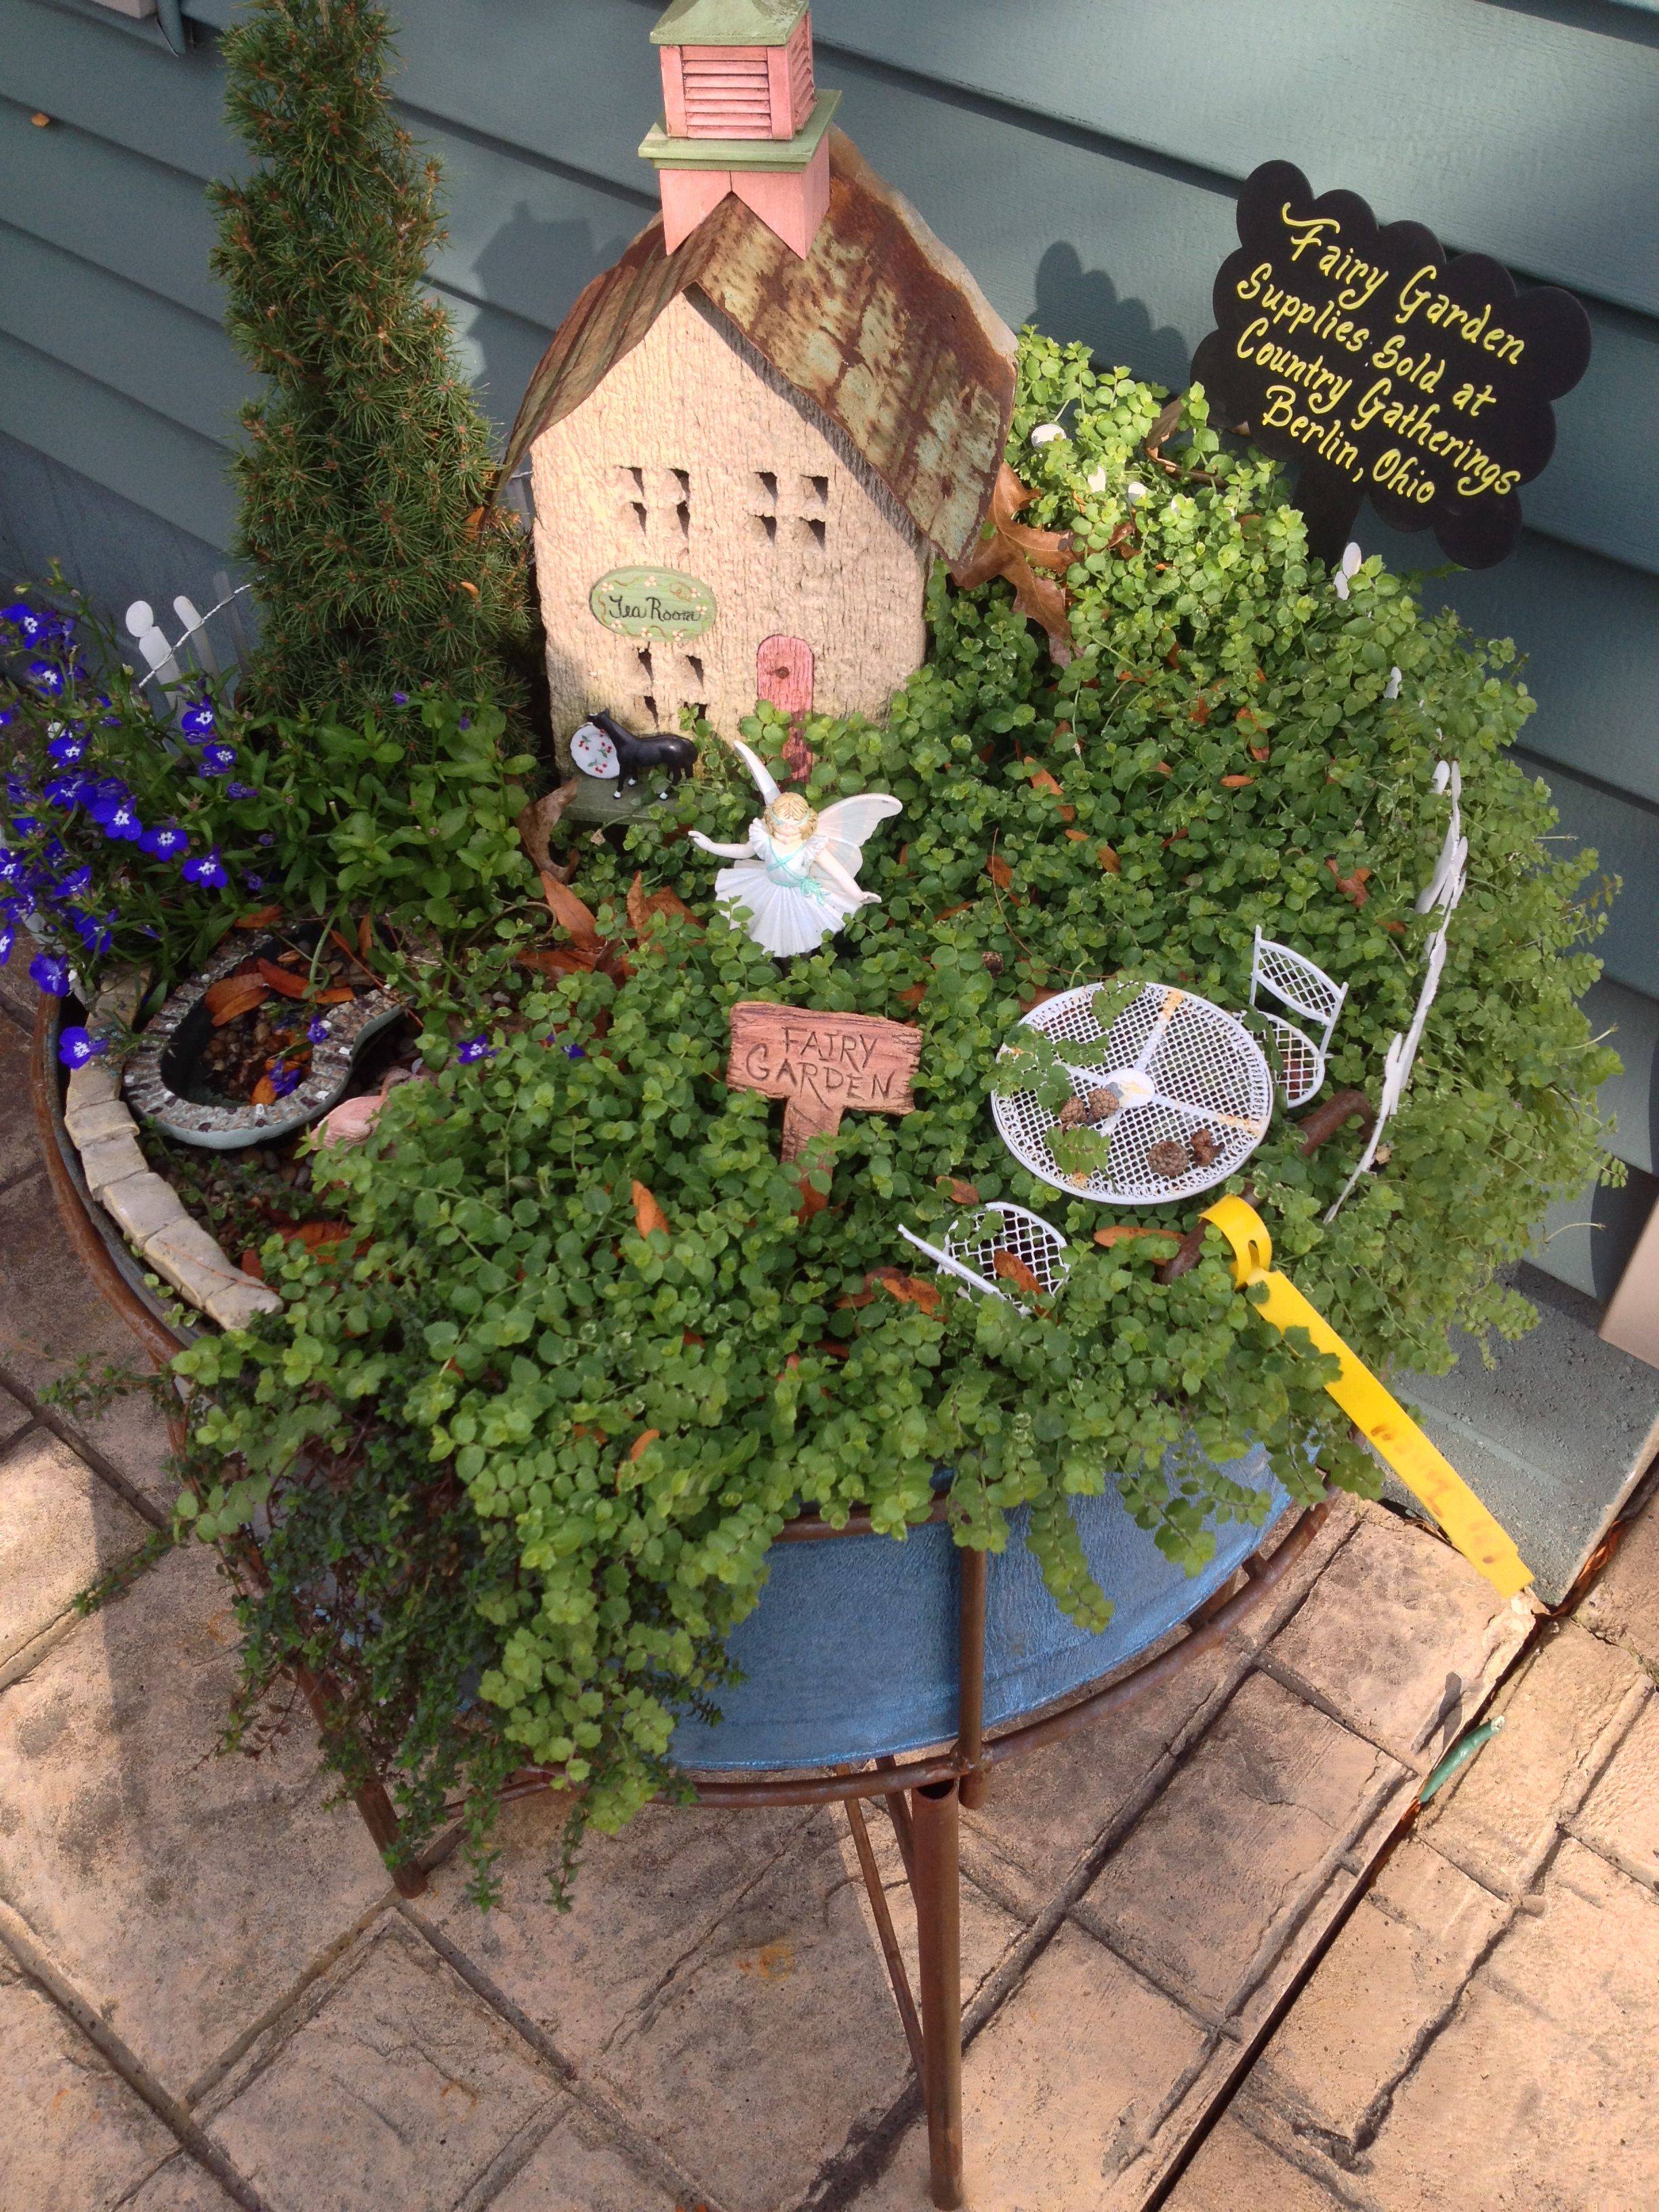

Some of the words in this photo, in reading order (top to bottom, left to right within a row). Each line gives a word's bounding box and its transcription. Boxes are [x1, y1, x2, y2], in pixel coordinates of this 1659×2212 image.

[1237, 263, 1369, 352] Supplies
[1372, 335, 1446, 393] Sold
[1452, 383, 1496, 416] at
[1282, 202, 1389, 310] Fairy
[1395, 265, 1525, 365] Garden
[1237, 318, 1352, 414] Country
[1351, 377, 1520, 496] Gatherings
[1263, 385, 1364, 483] Berlin,
[1373, 448, 1435, 504] Ohio
[609, 595, 646, 619] Tea
[646, 596, 700, 621] Room
[746, 1043, 895, 1111] GARDEN
[781, 1026, 877, 1073] FAIRY
